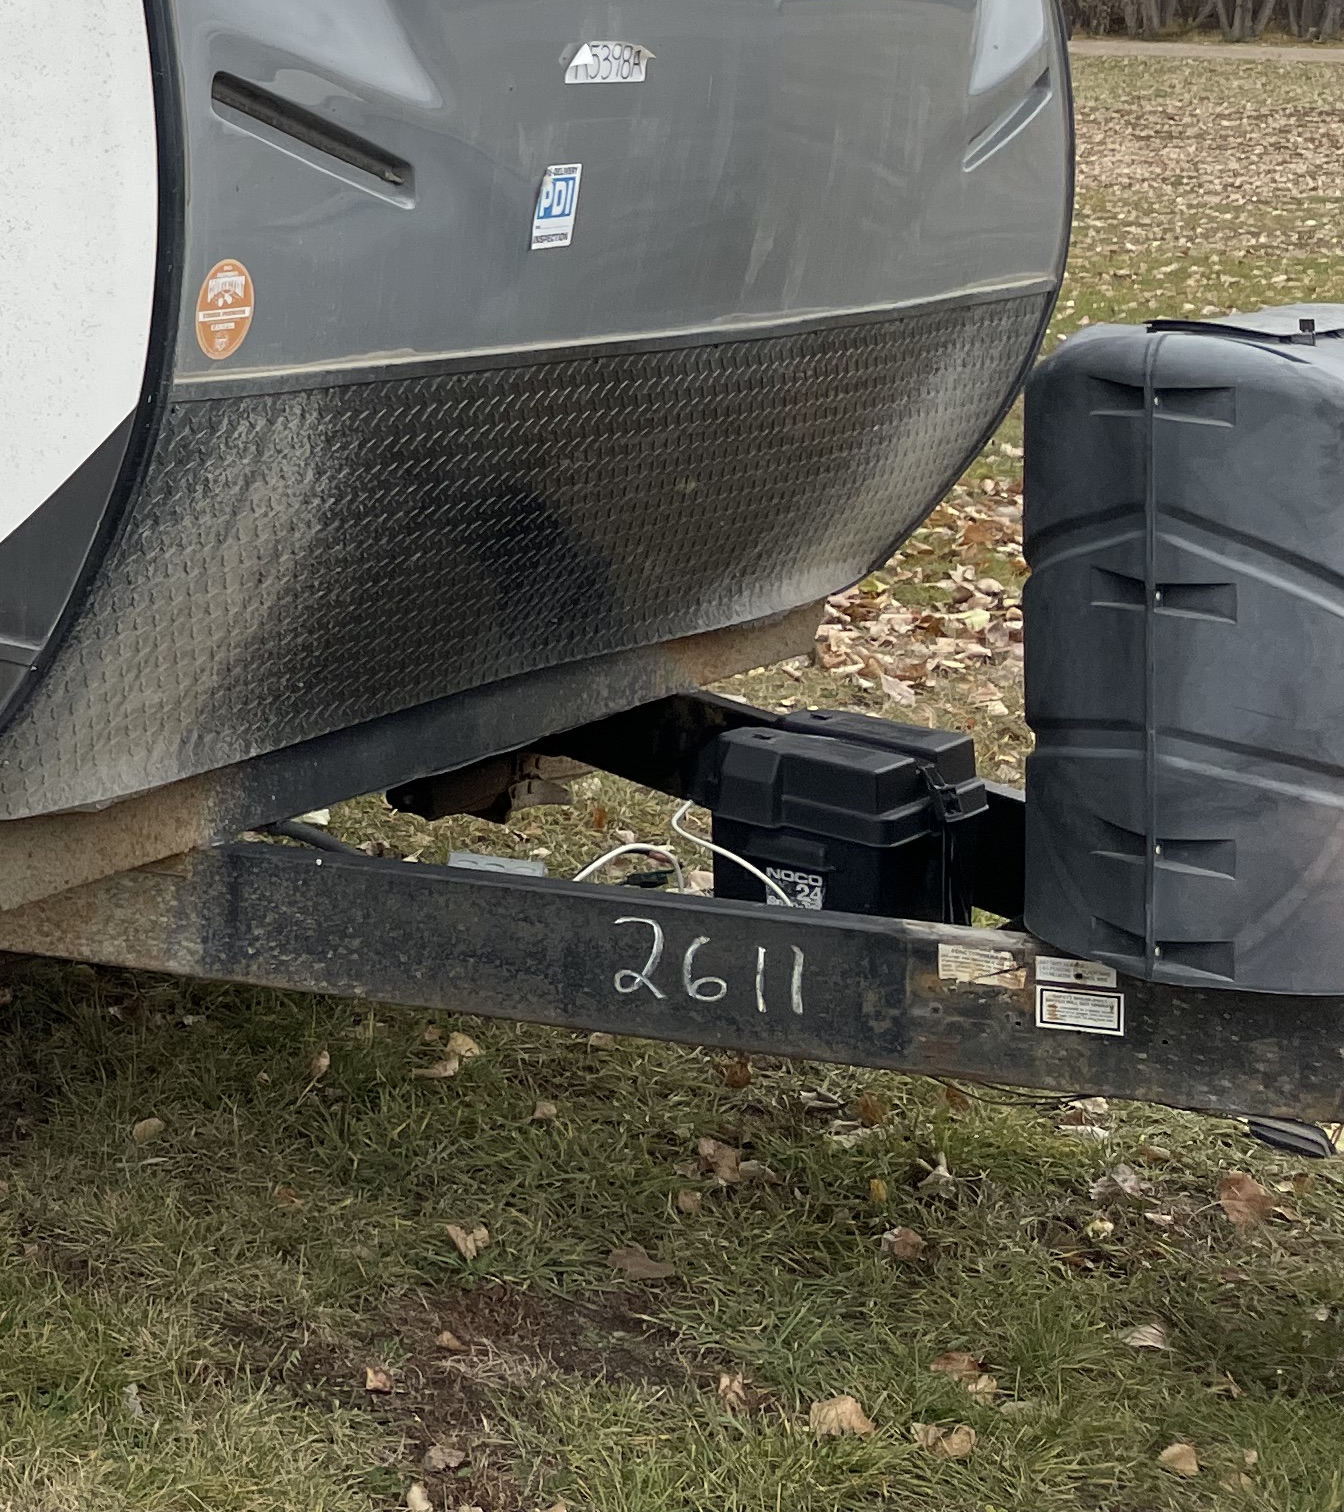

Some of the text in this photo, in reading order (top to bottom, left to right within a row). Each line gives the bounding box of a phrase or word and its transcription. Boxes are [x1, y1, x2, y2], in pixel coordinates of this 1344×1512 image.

[540, 180, 574, 217] PDI
[766, 867, 823, 887] NOCO
[795, 883, 822, 903] 24
[613, 917, 804, 1015] 2611
